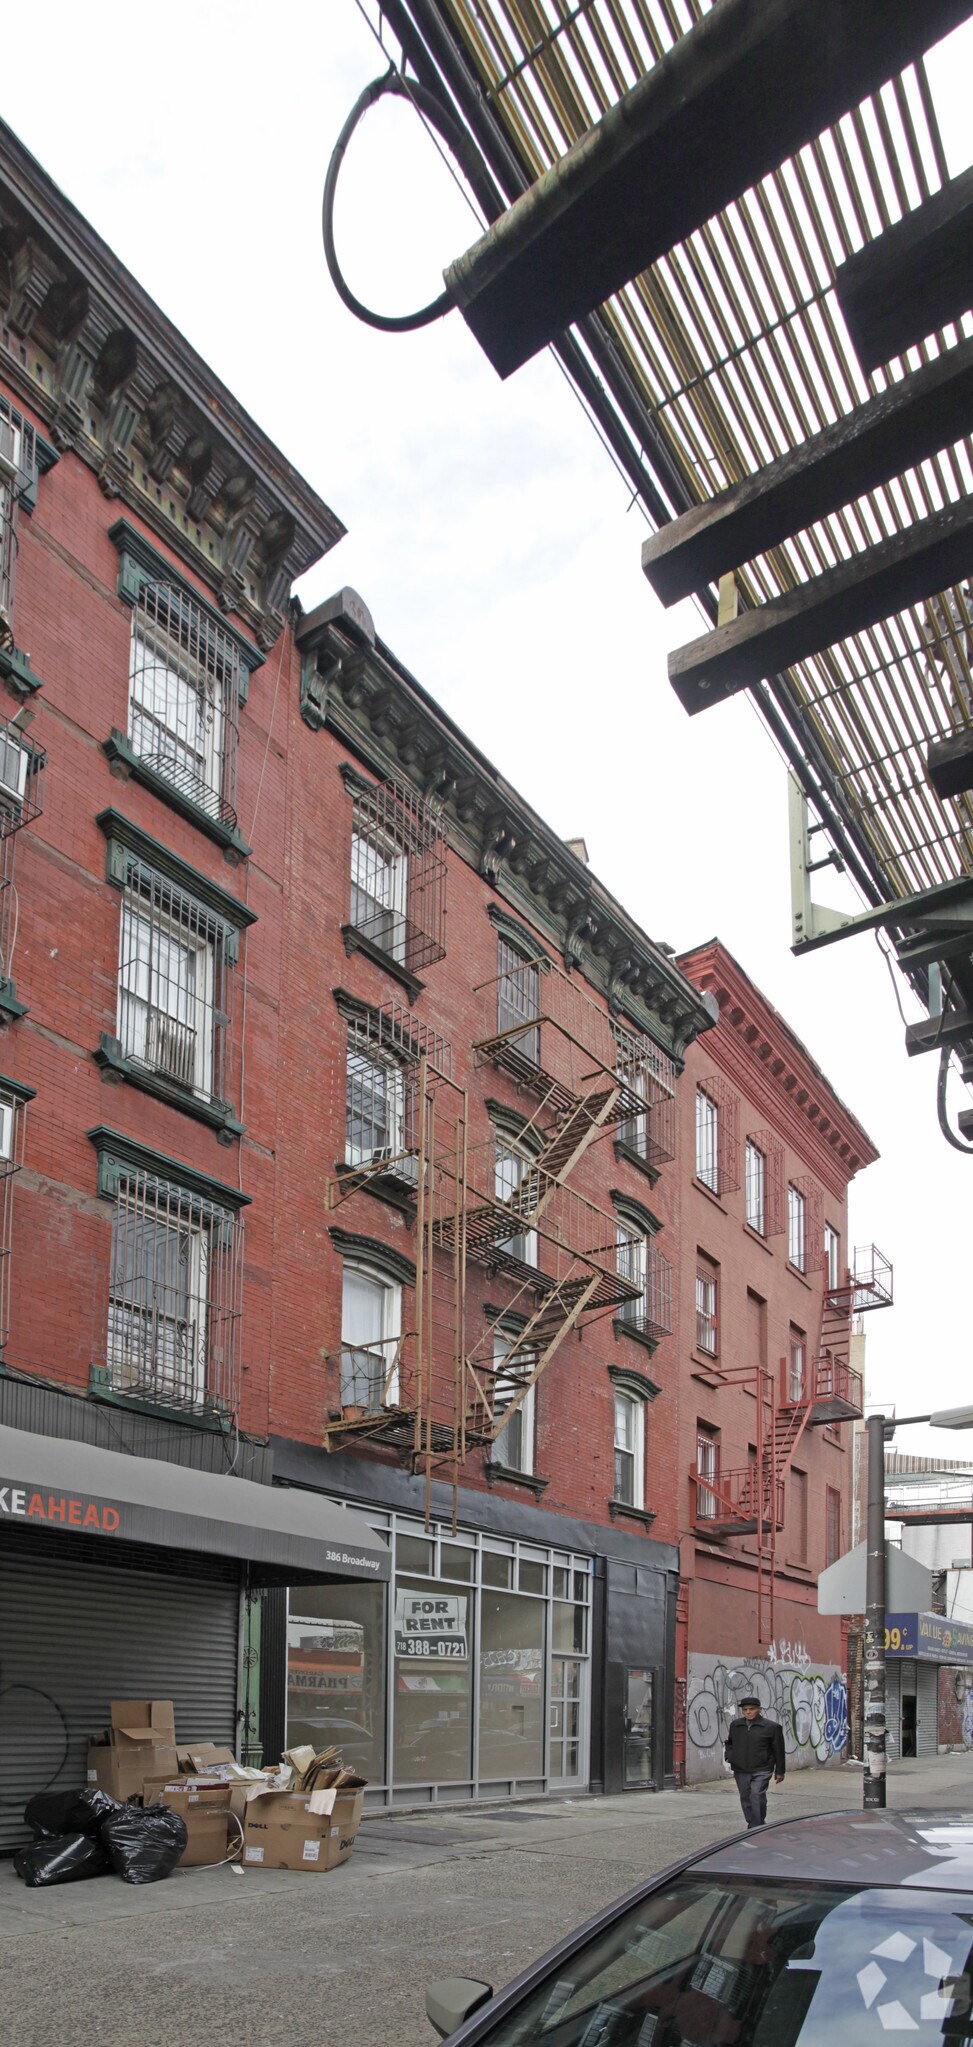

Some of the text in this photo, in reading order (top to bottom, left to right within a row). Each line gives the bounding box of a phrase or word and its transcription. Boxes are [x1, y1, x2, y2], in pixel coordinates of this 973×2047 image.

[326, 1551, 380, 1570] 386 Broadway
[411, 1601, 448, 1614] FOR
[406, 1617, 455, 1632] RENT
[397, 1639, 465, 1657] 718 388-0721
